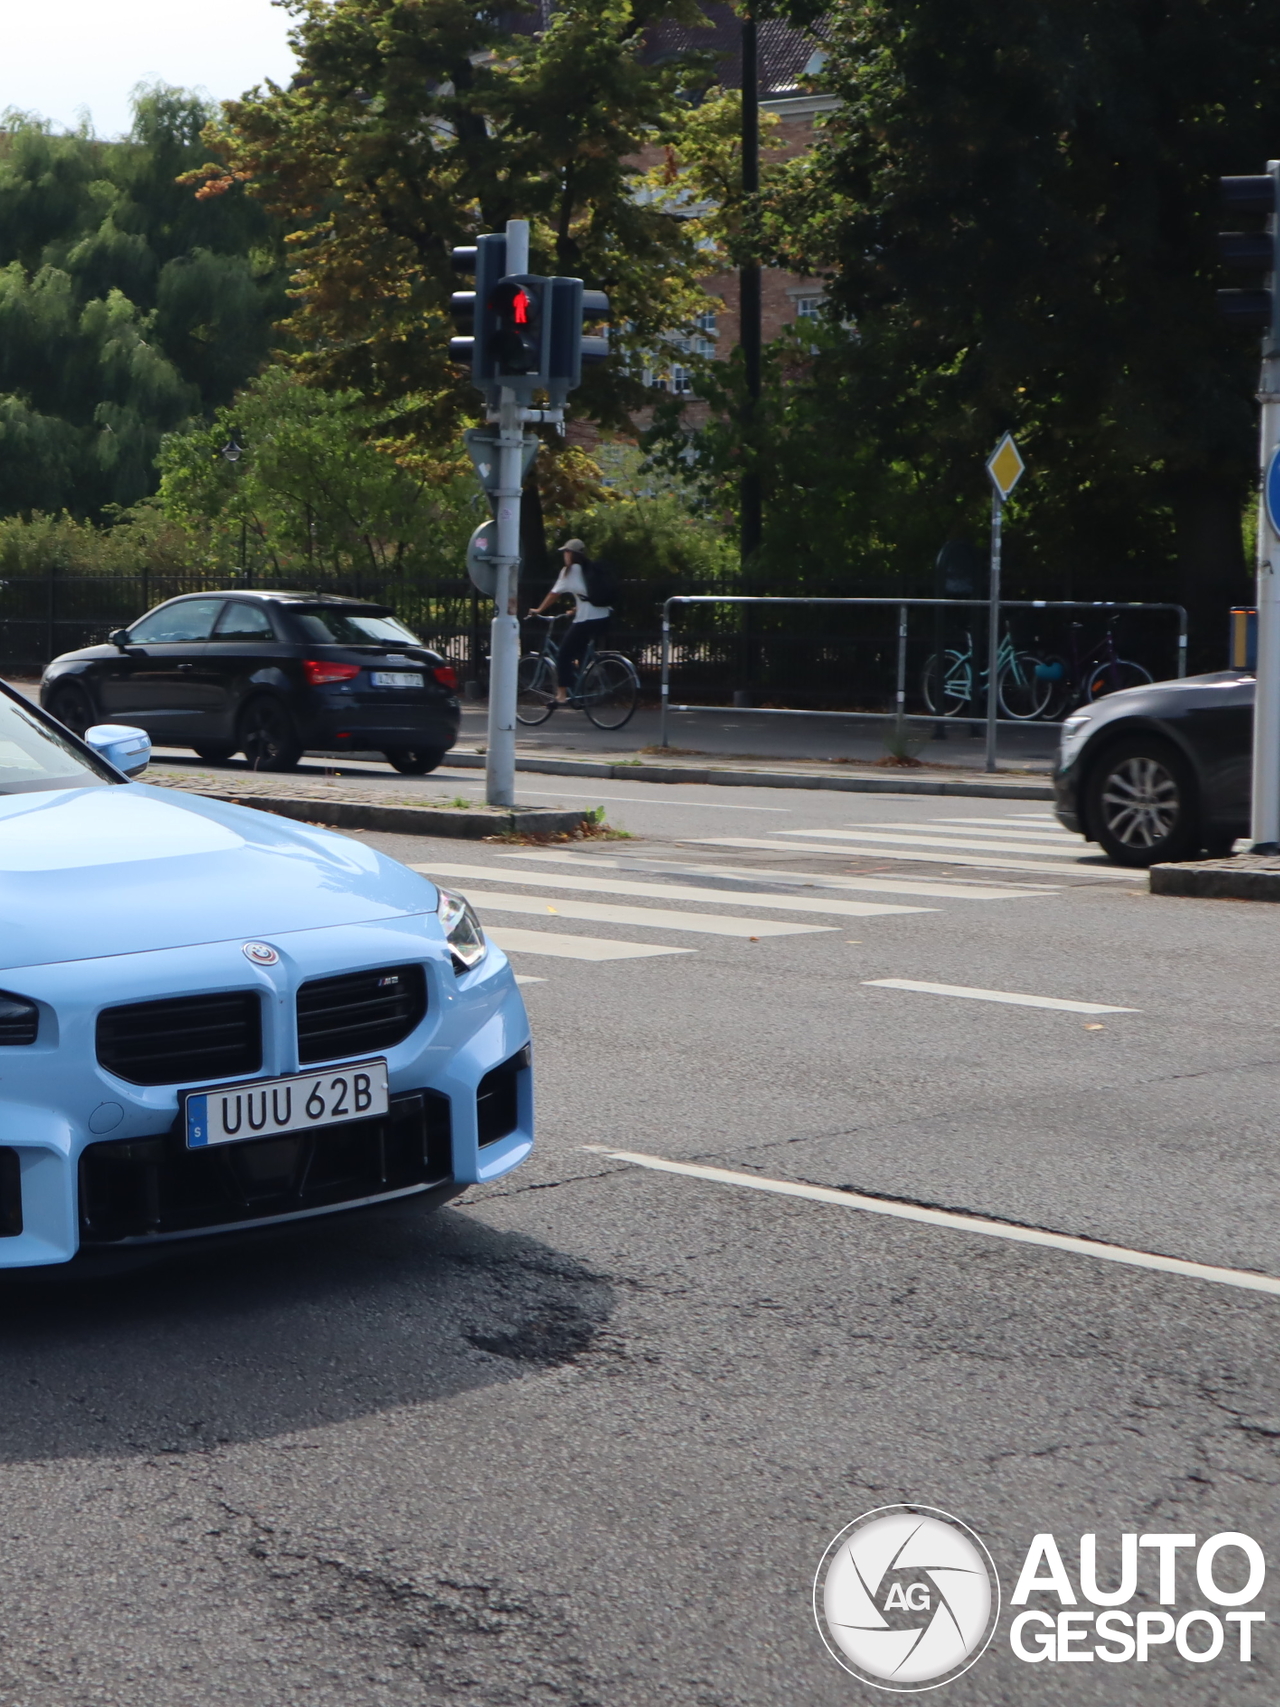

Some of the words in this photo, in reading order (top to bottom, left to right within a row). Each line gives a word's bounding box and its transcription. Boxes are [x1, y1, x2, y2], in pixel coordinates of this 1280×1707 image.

[222, 1086, 292, 1135] UUU
[305, 1073, 373, 1120] 62B
[194, 1127, 202, 1138] S
